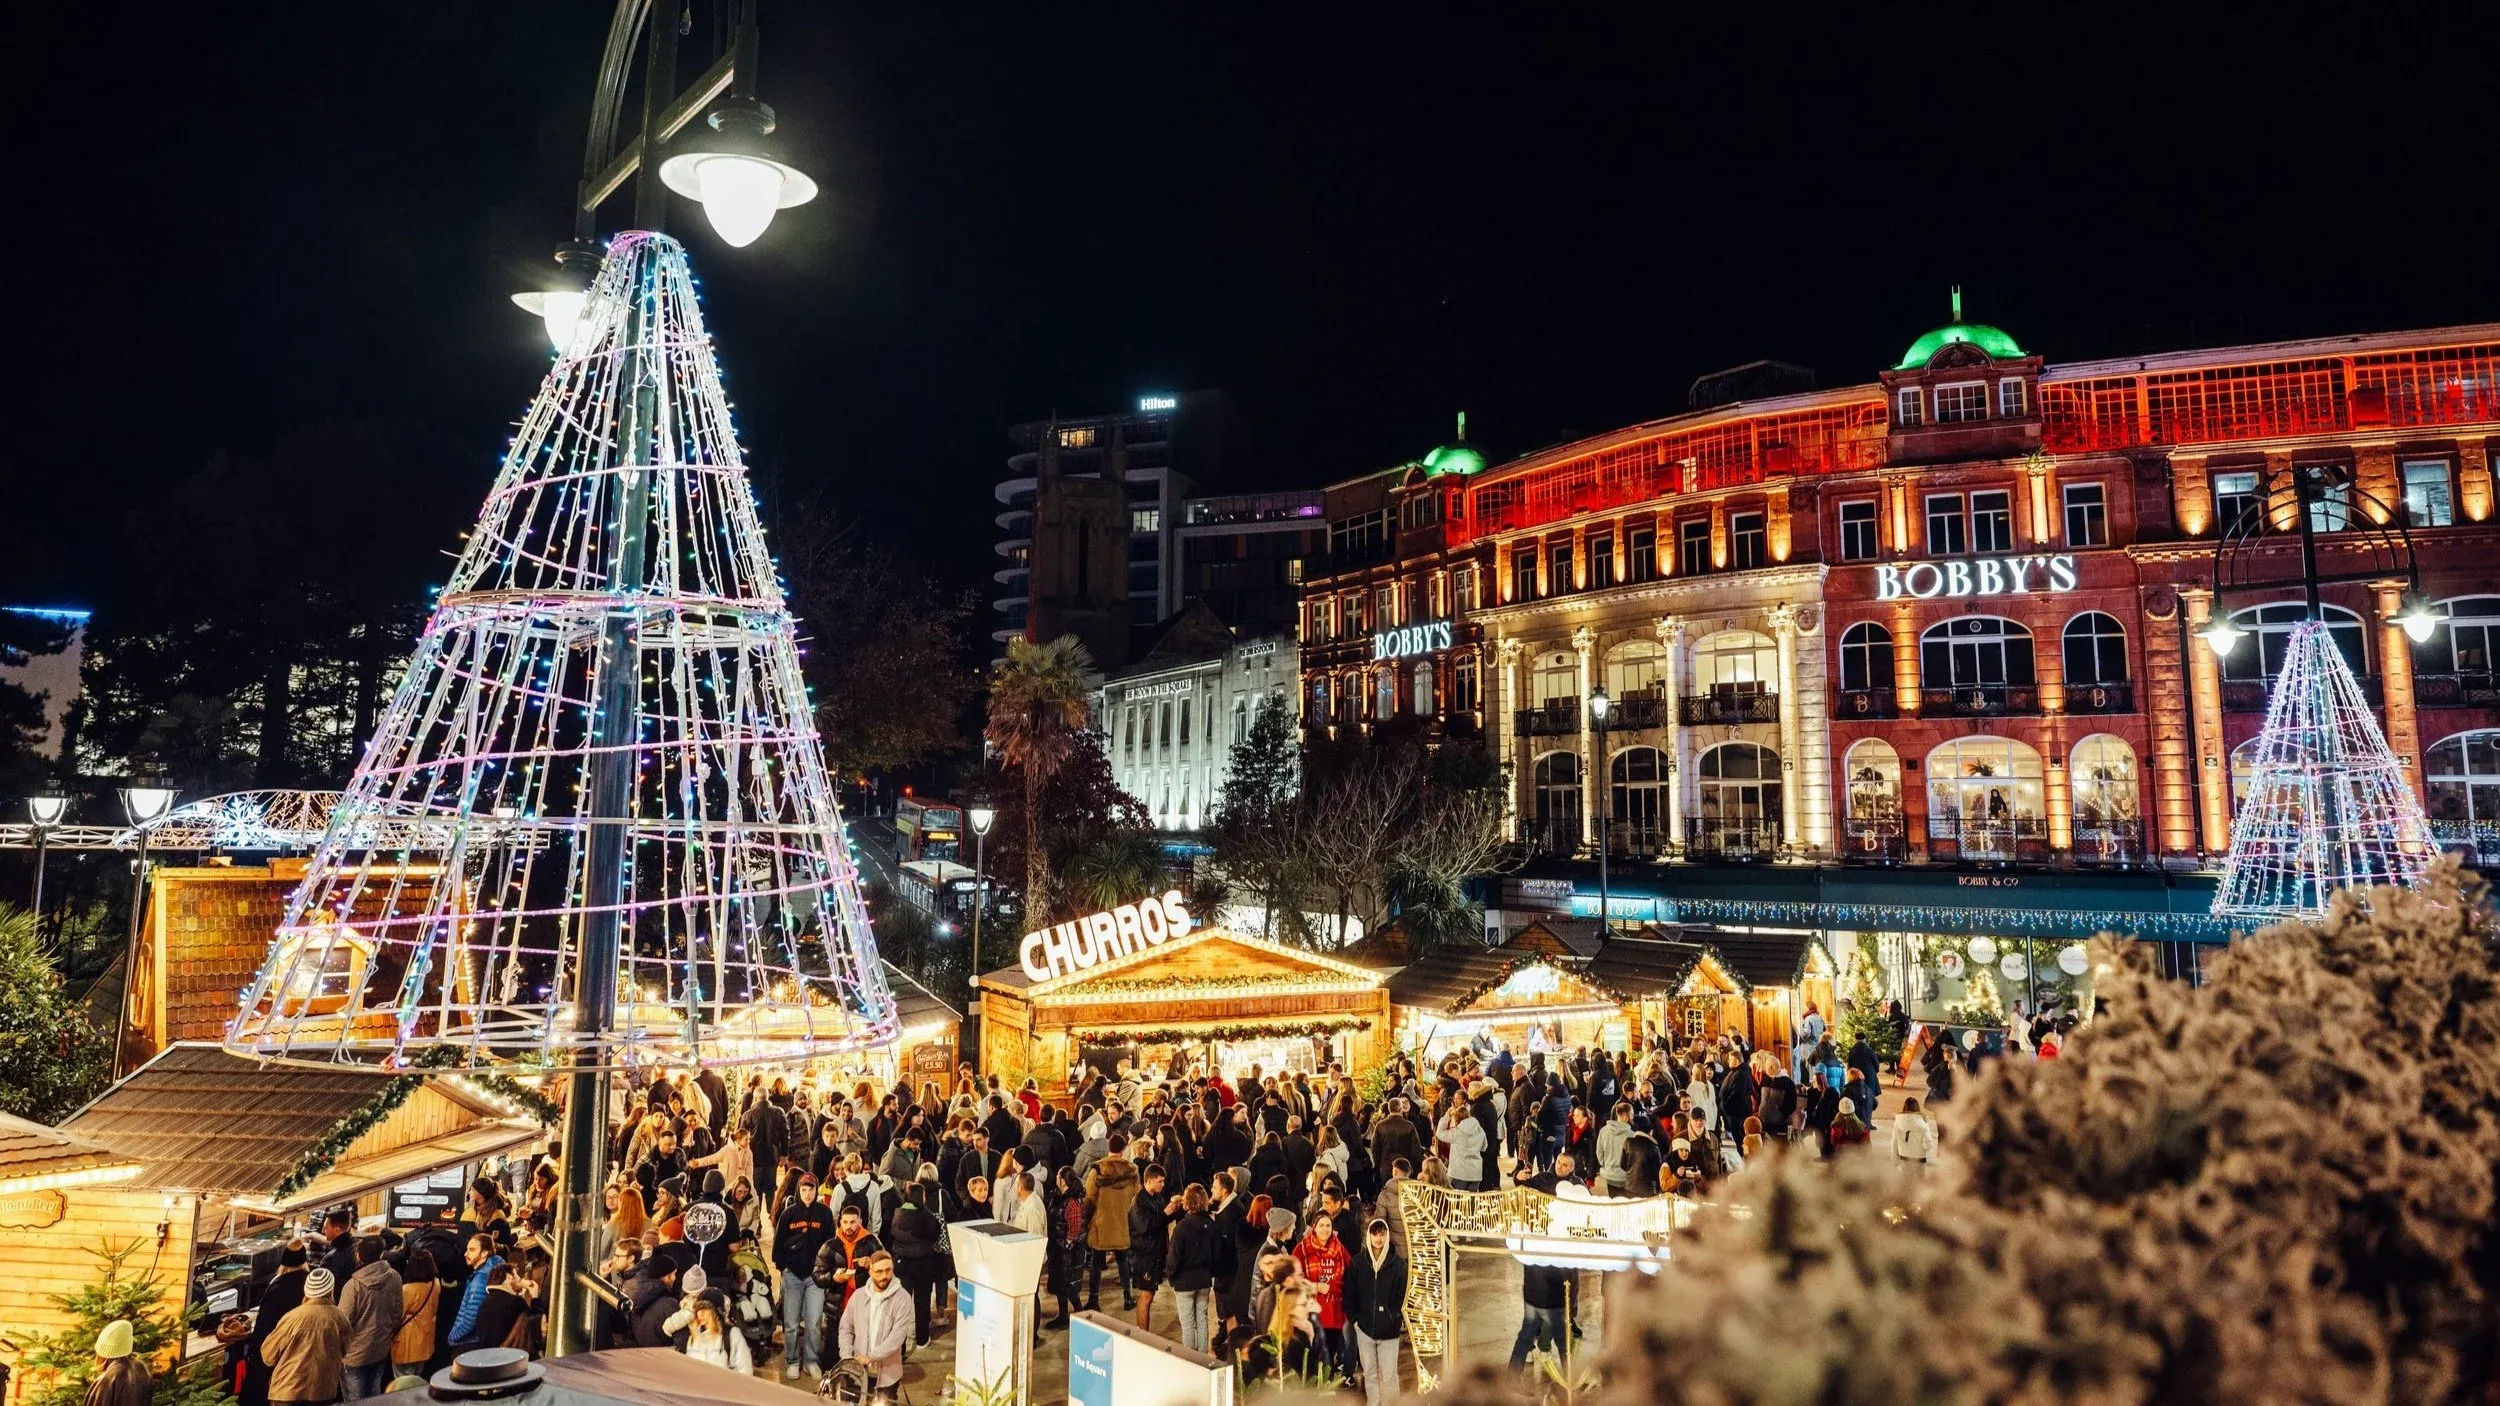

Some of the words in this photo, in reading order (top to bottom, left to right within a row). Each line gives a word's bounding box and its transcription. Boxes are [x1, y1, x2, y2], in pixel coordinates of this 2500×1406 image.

[1141, 397, 1175, 410] Hilton
[1875, 555, 2077, 601] BOBBY'S
[1374, 621, 1452, 661] BOBBY'S
[1863, 829, 1877, 851] B
[1958, 876, 1989, 886] BOBBY
[1992, 877, 2001, 887] &
[1019, 889, 1192, 982] CHURROS
[925, 1061, 944, 1070] £5.50
[32, 1198, 60, 1214] Beef
[1074, 1354, 1086, 1368] The
[1086, 1359, 1107, 1378] Square
